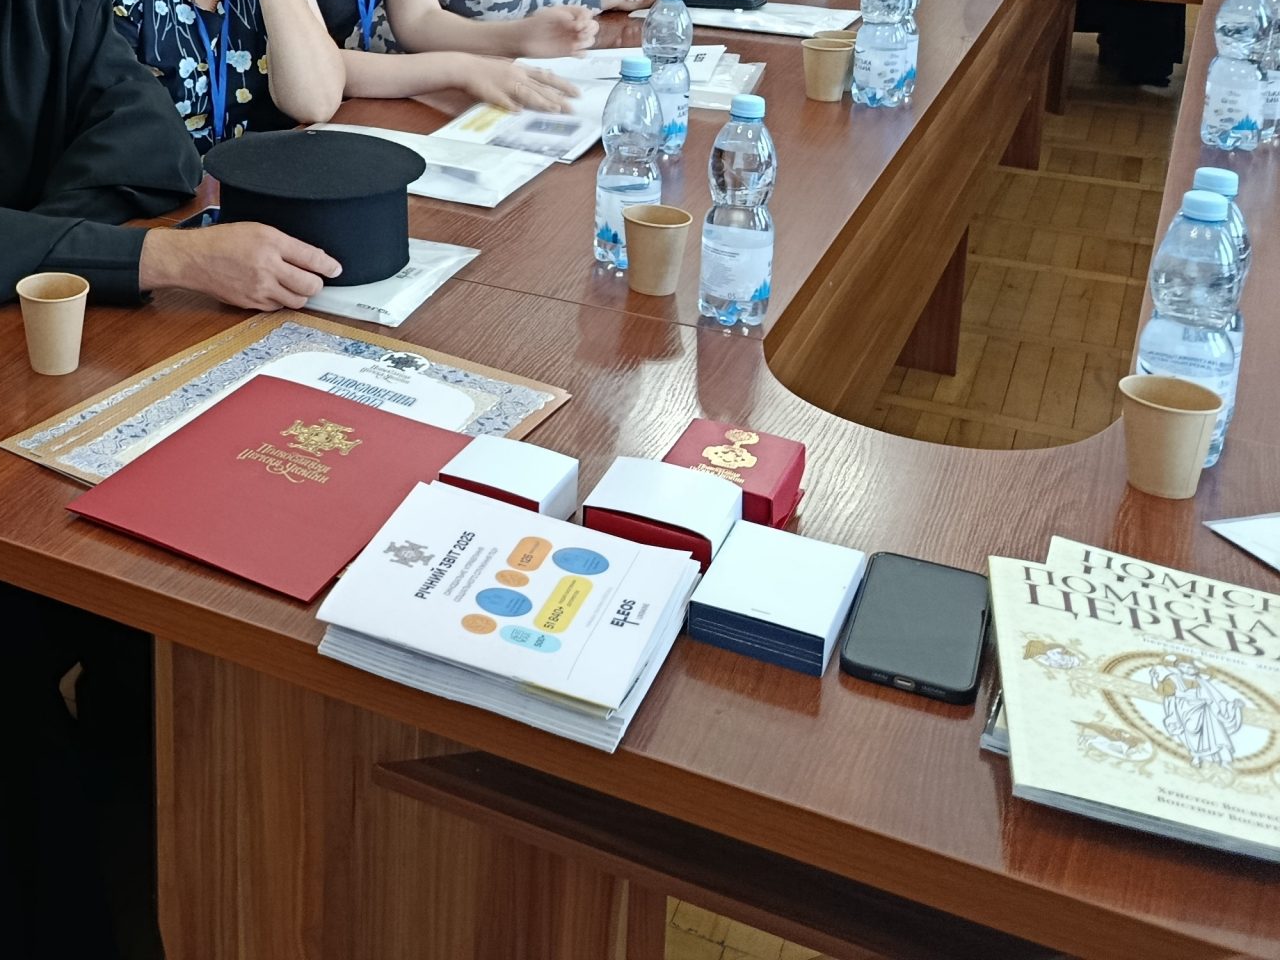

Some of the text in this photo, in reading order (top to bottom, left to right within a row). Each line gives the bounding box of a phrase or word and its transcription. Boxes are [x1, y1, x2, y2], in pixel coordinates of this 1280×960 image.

[414, 567, 448, 599] РІЧНИЙ
[438, 549, 461, 569] ЗВІТ
[453, 530, 476, 551] 2025
[610, 599, 639, 627] ELEOS
[1024, 582, 1280, 661] ЦЕРКВ
